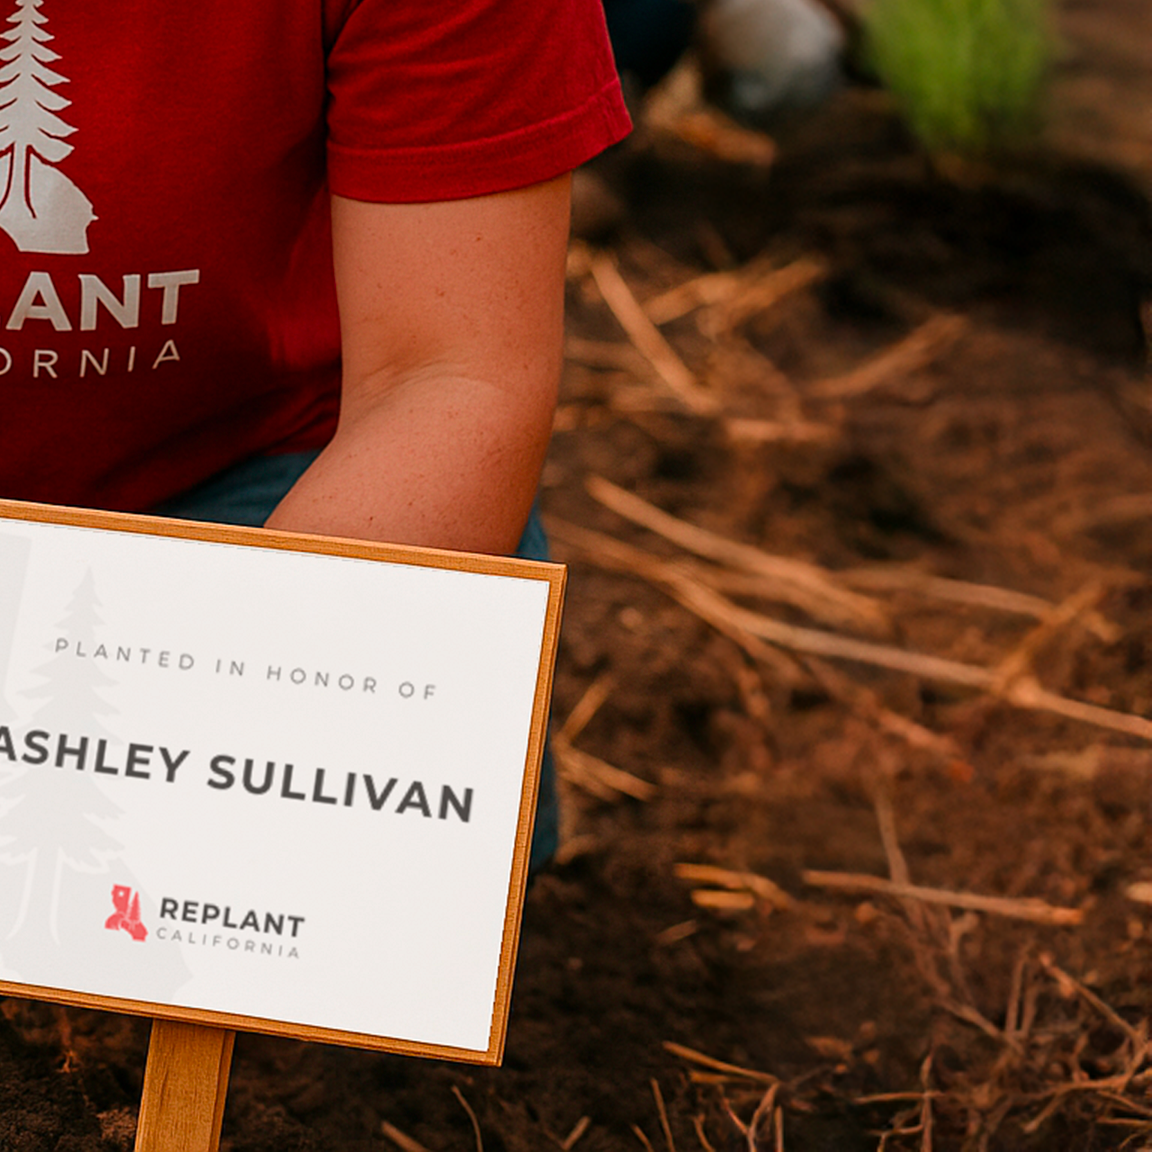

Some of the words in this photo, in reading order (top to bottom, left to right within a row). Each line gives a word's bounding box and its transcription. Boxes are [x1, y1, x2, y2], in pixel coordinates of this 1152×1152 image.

[54, 637, 195, 671] PLANTED
[214, 658, 245, 677] IN
[266, 665, 377, 694] HONOR
[398, 681, 437, 701] OF
[205, 753, 475, 824] SULLIVAN
[155, 926, 300, 960] CALIFORNIA
[159, 896, 306, 939] REPLANT
